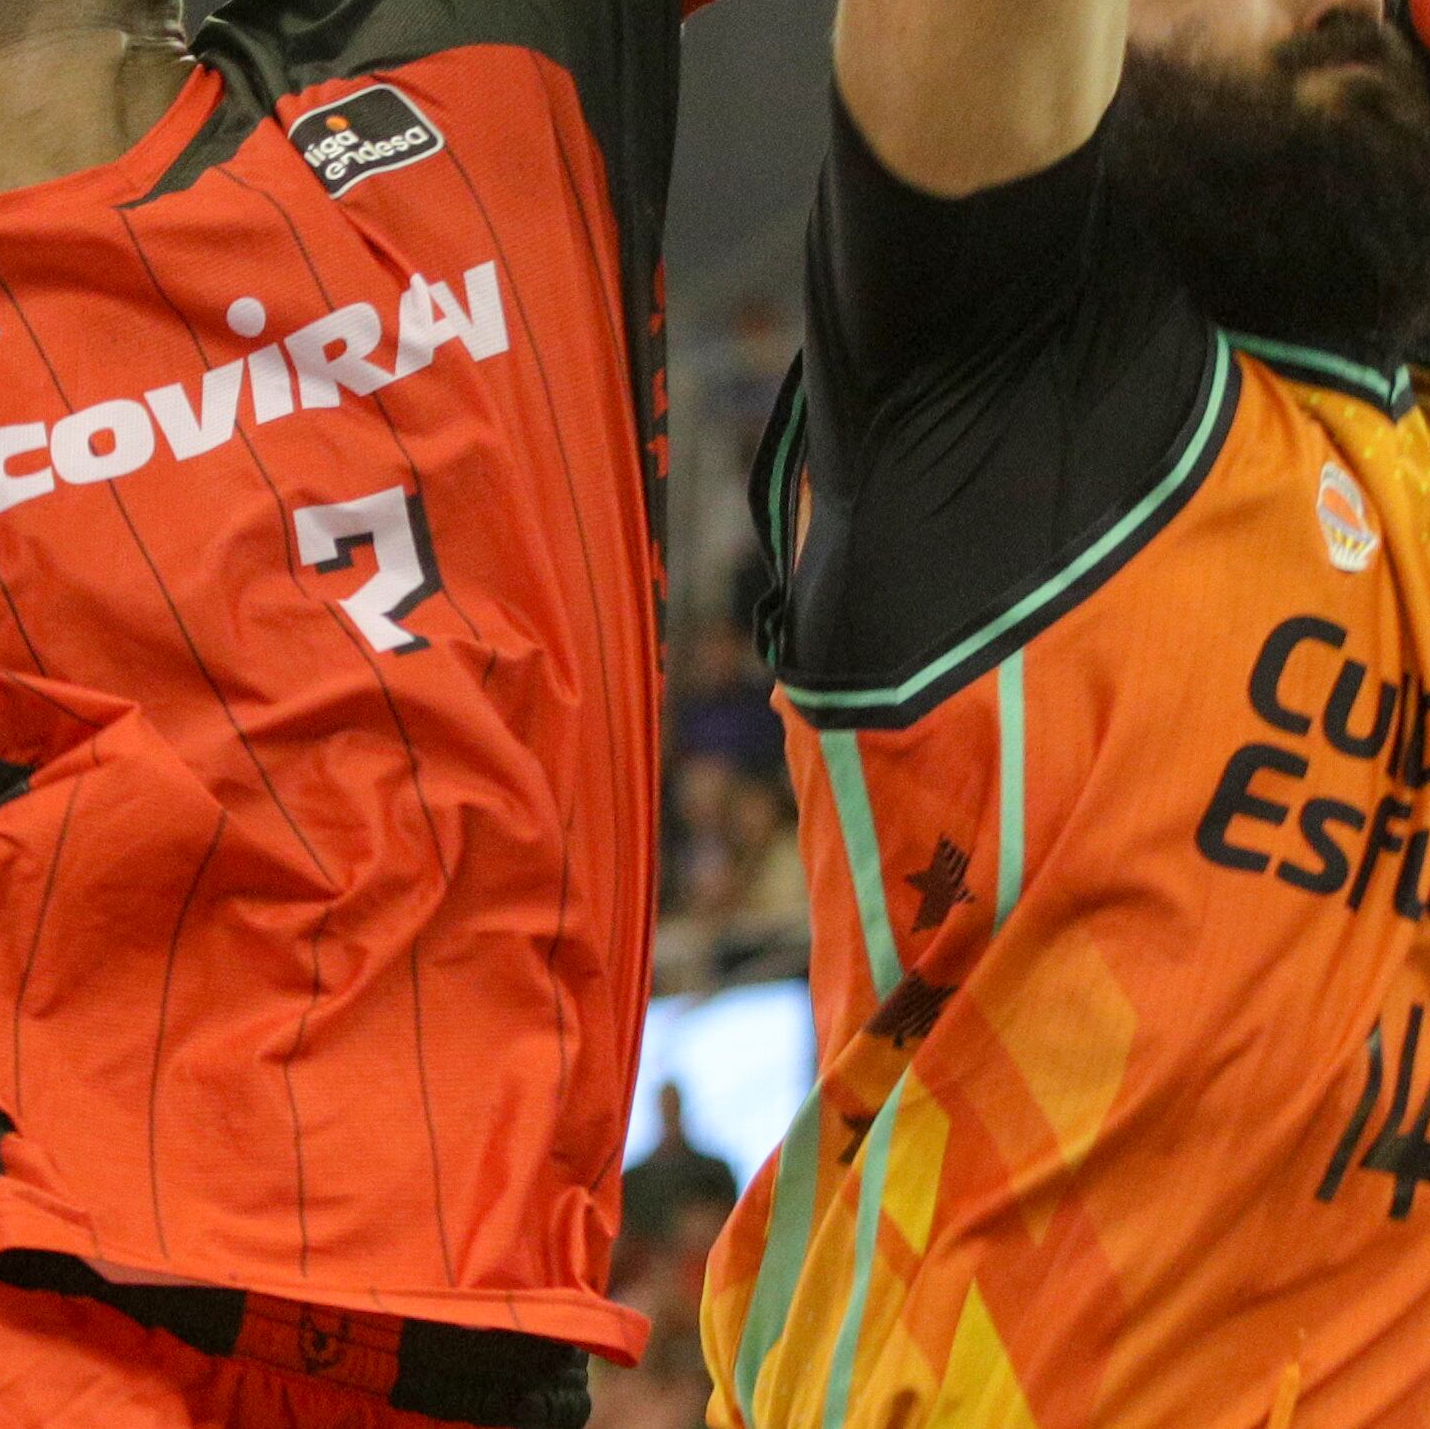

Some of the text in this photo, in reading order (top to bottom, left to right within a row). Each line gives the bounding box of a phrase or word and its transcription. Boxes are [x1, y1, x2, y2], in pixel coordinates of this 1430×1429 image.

[303, 130, 359, 168] liga
[325, 126, 429, 180] endesa
[293, 485, 443, 656] 7
